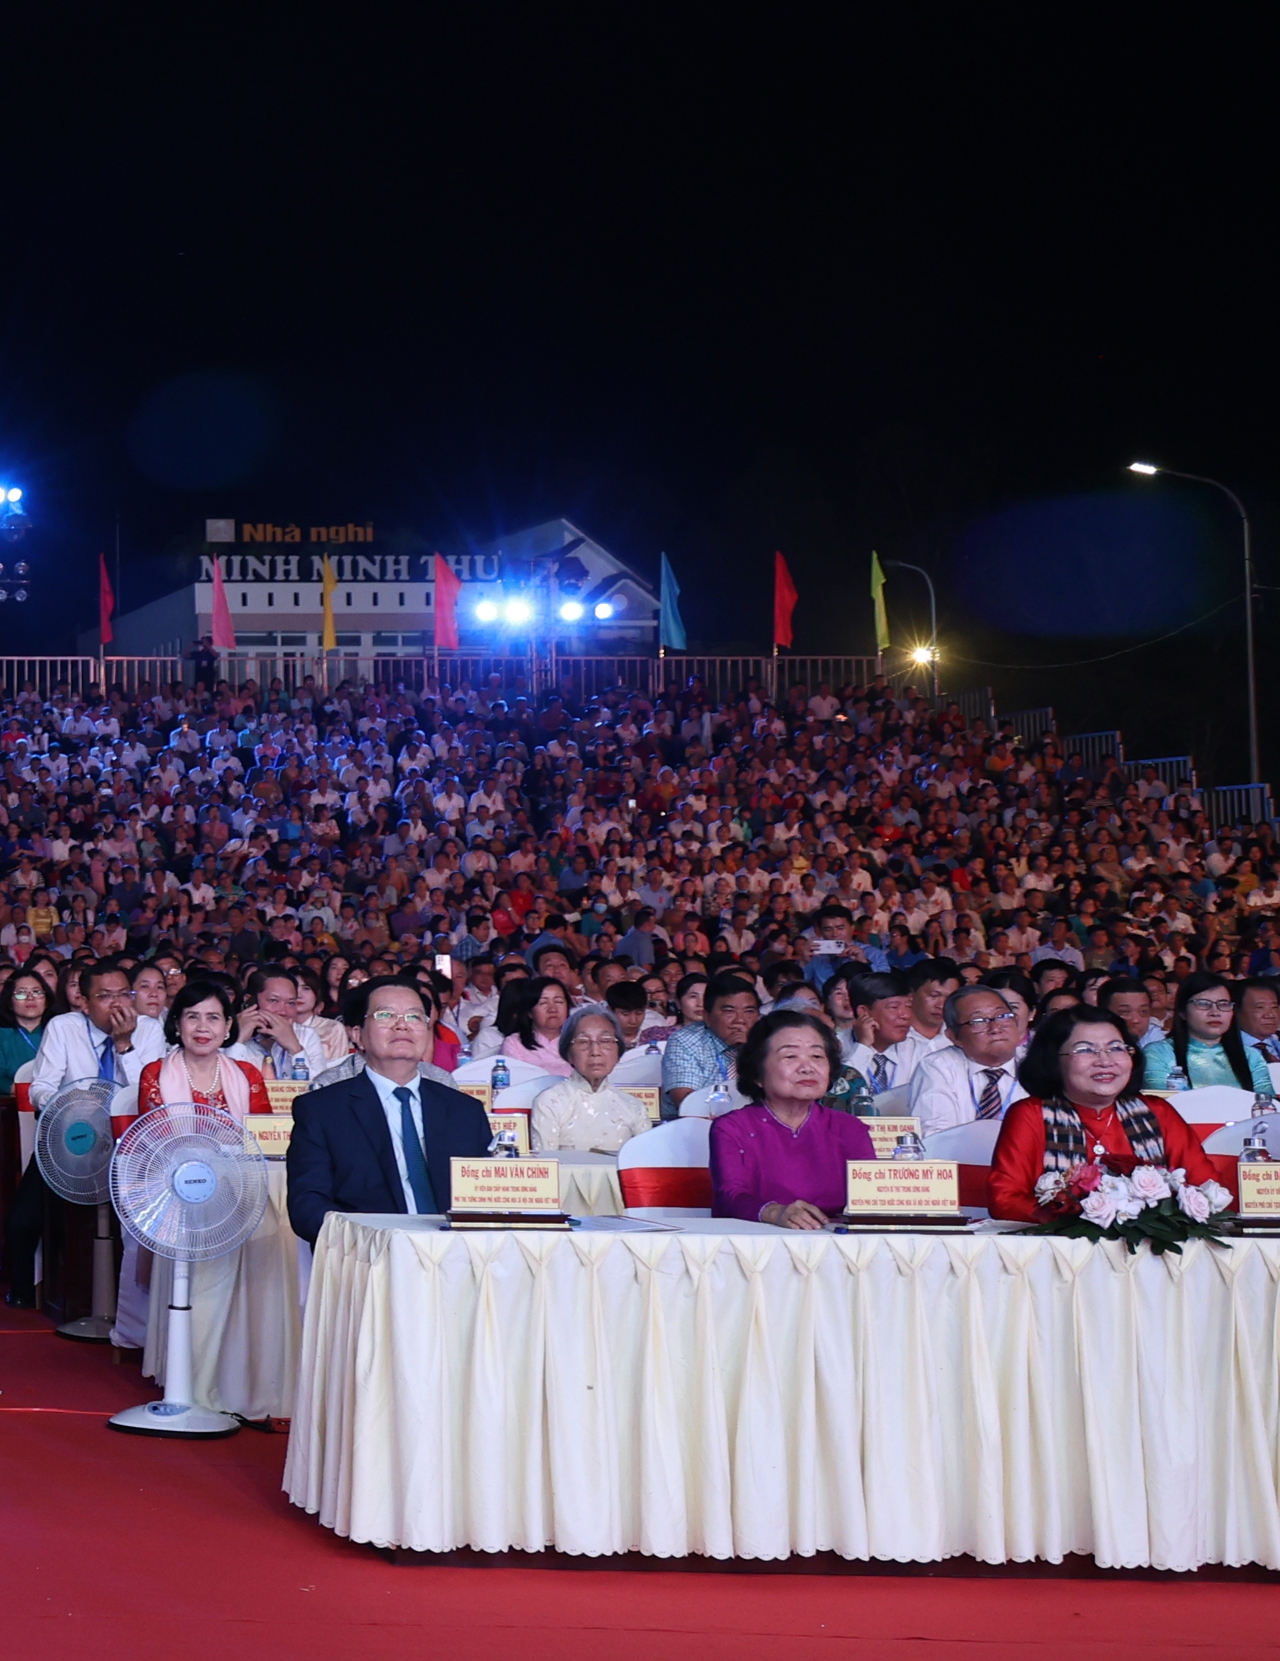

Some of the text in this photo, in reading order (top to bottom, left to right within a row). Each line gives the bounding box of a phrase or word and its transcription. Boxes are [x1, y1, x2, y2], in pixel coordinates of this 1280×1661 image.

[242, 522, 374, 544] Nhà nghỉ
[199, 555, 300, 580] MINH
[310, 555, 410, 580] MINH
[461, 1164, 480, 1180] Đồng
[494, 1166, 508, 1178] MAI
[510, 1165, 524, 1178] VĂN
[527, 1164, 549, 1179] CHÍNH
[852, 1167, 872, 1181] Đồng
[922, 1166, 933, 1179] MỸ
[936, 1169, 953, 1180] HOA
